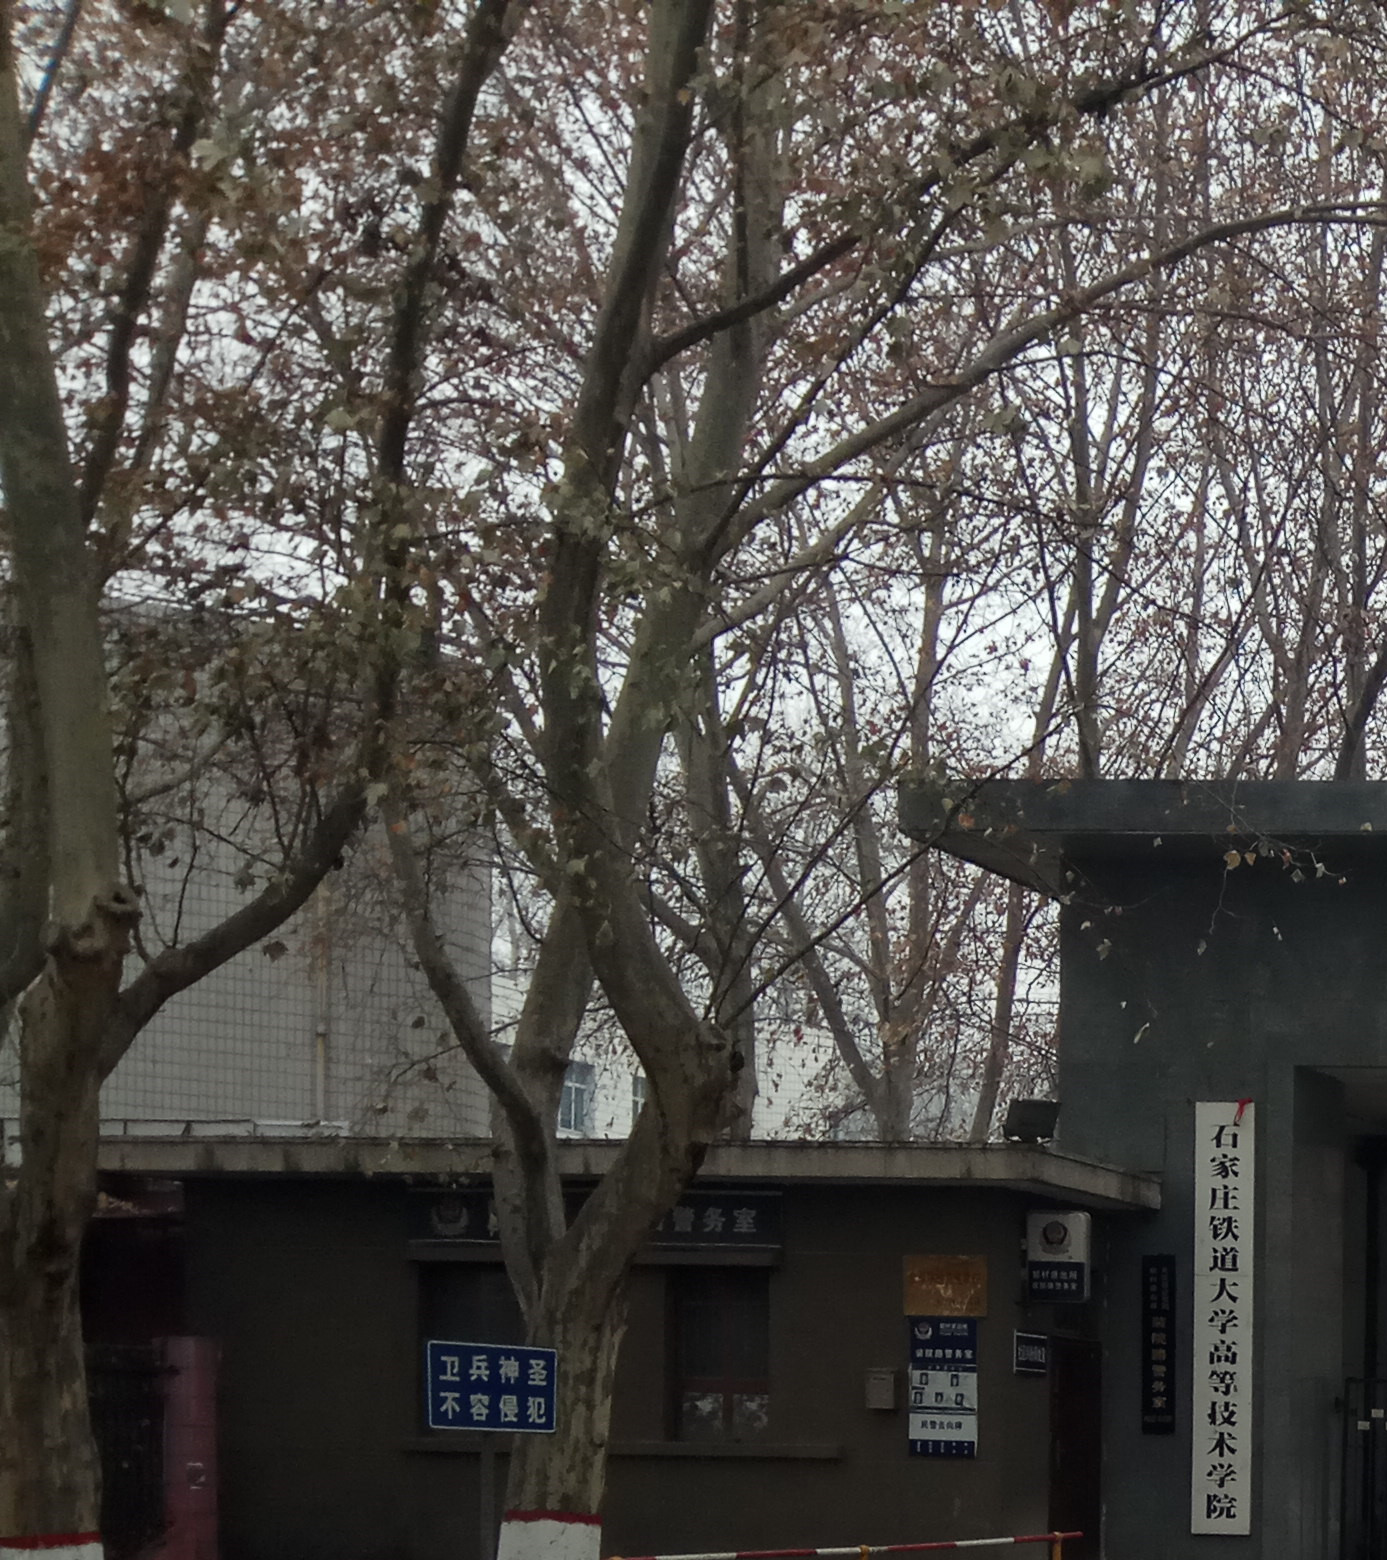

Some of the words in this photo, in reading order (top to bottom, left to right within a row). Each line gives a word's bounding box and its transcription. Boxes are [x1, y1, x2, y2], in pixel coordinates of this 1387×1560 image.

[1204, 1121, 1241, 1521] 石家庄铁道大学高等技术学院
[438, 1354, 549, 1388] 卫兵神圣
[438, 1390, 548, 1425] 不容侵犯
